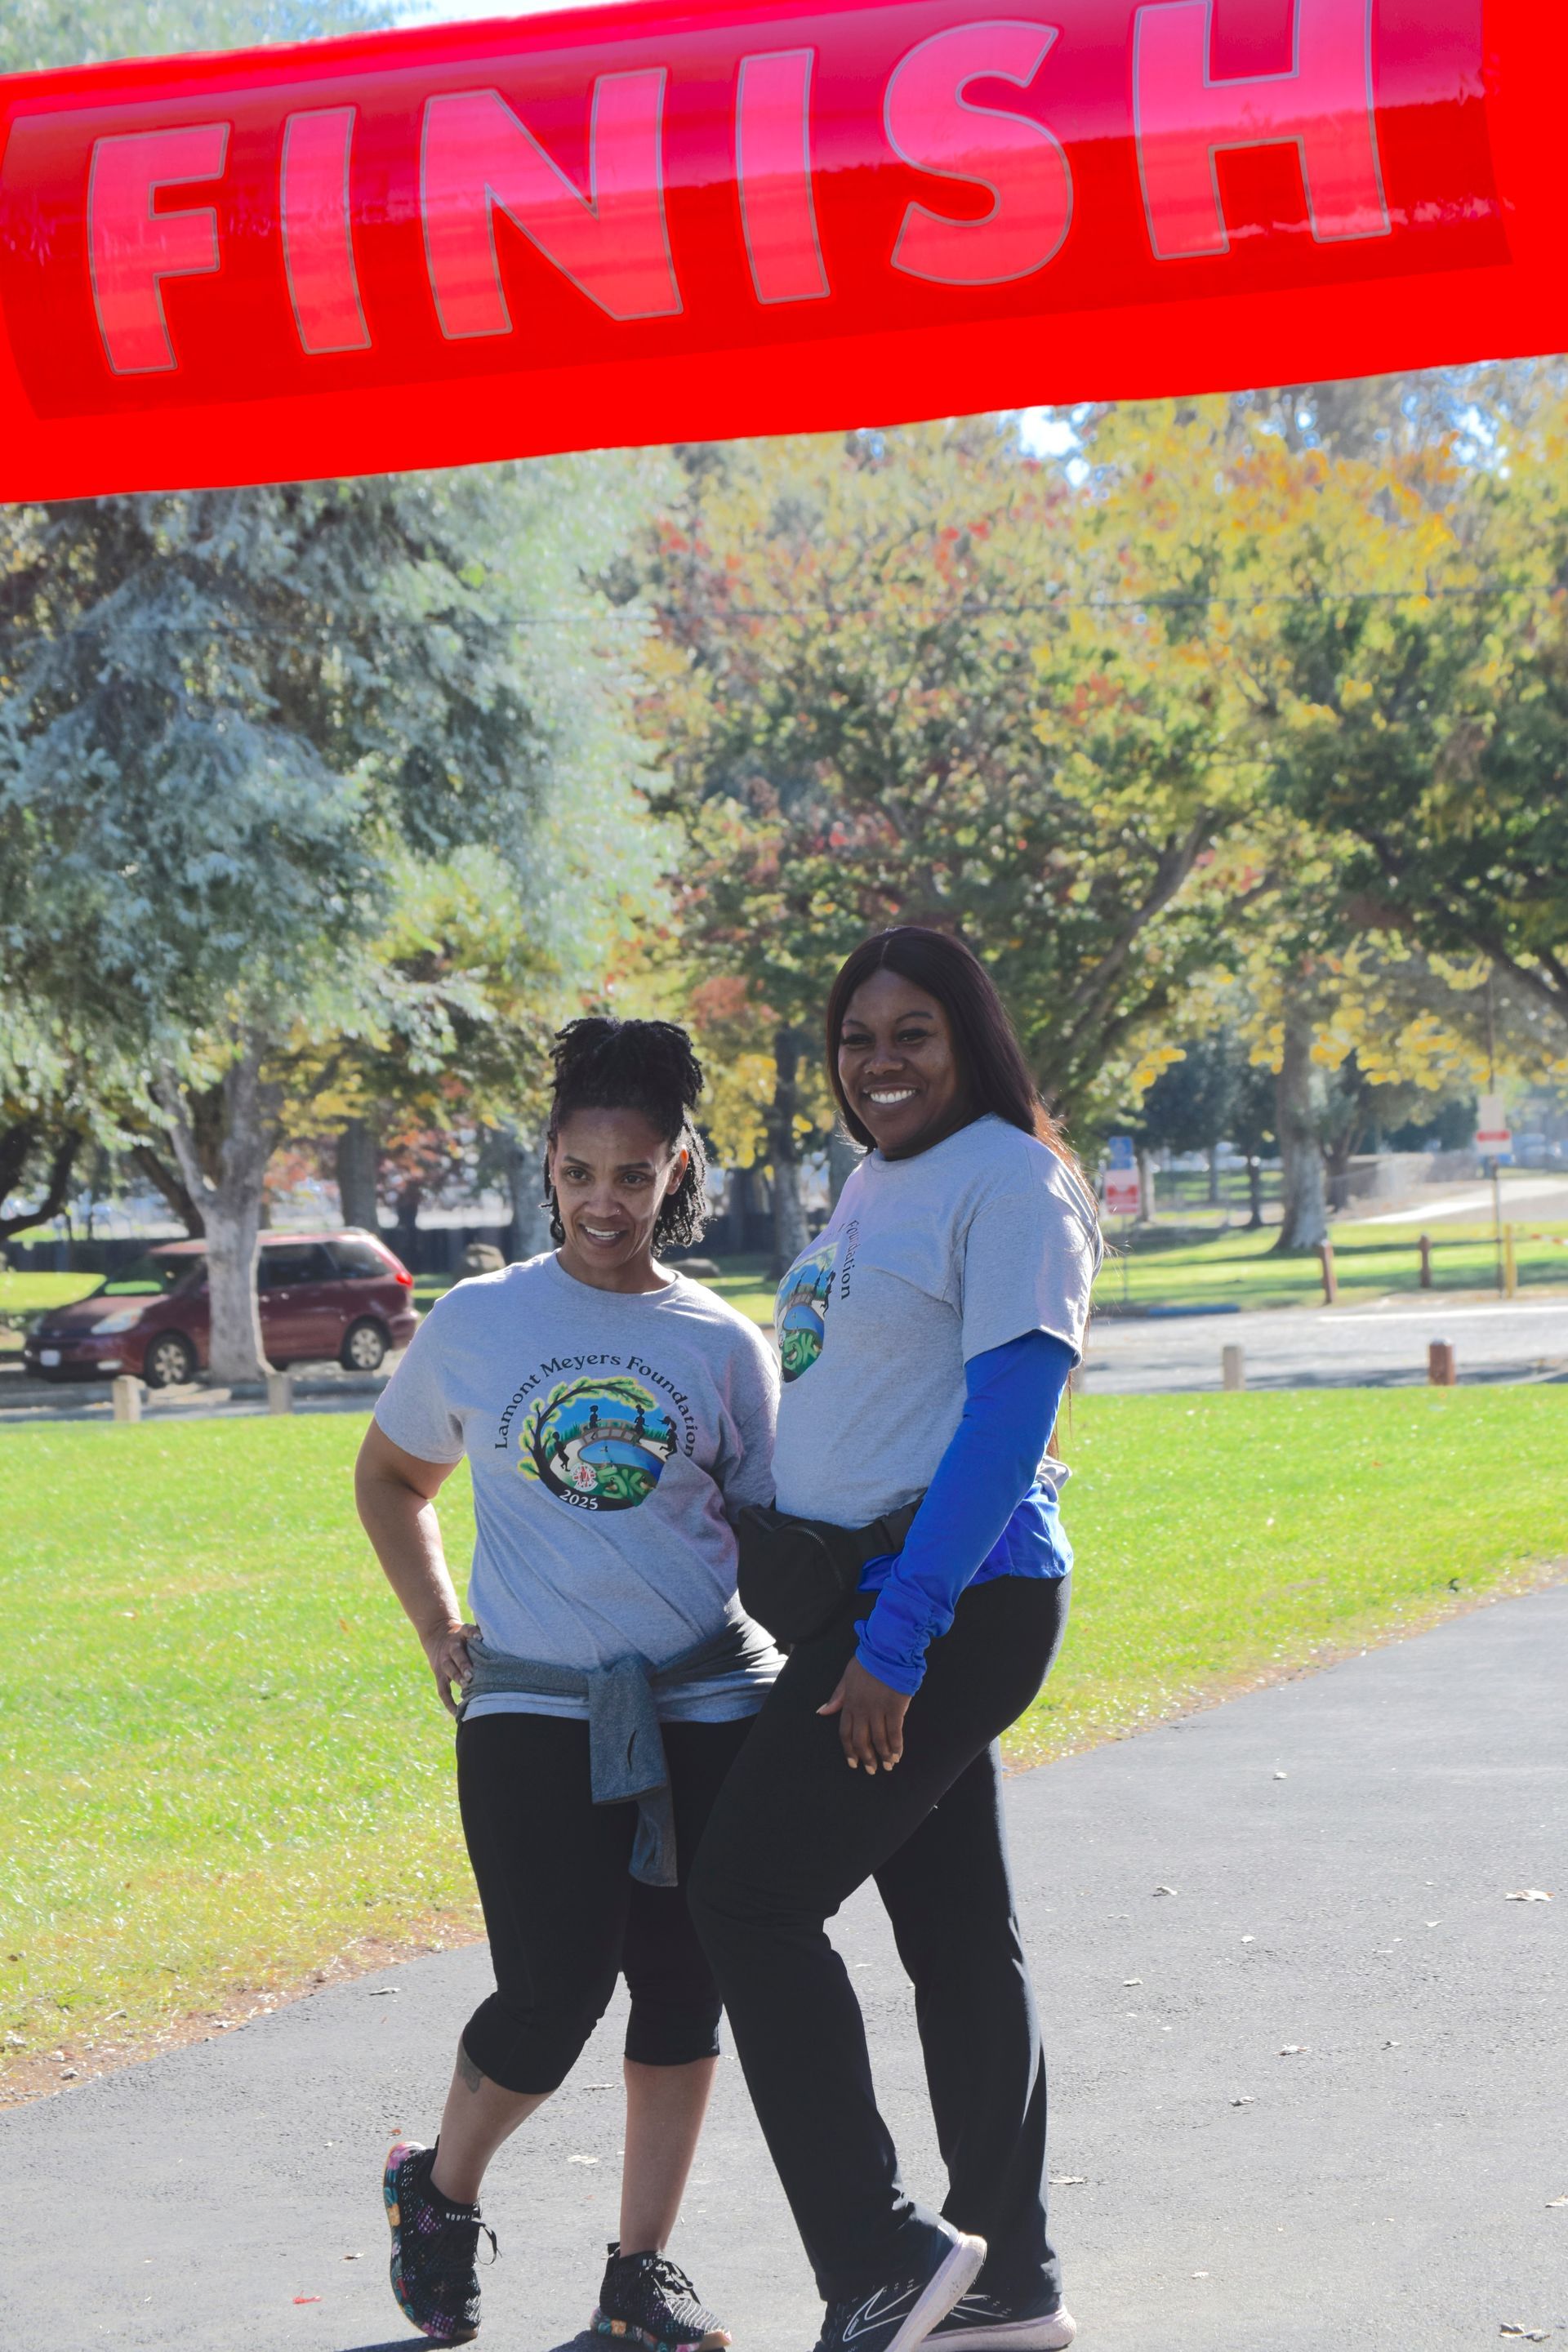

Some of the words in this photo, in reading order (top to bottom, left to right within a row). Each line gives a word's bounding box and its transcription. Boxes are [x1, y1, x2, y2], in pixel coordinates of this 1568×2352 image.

[87, 0, 1392, 376] FINISH
[840, 1219, 862, 1301] Foundation
[494, 1374, 542, 1450] Lamont
[539, 1353, 621, 1379] Meyers
[626, 1355, 699, 1459] Foundation
[559, 1489, 599, 1511] 2025
